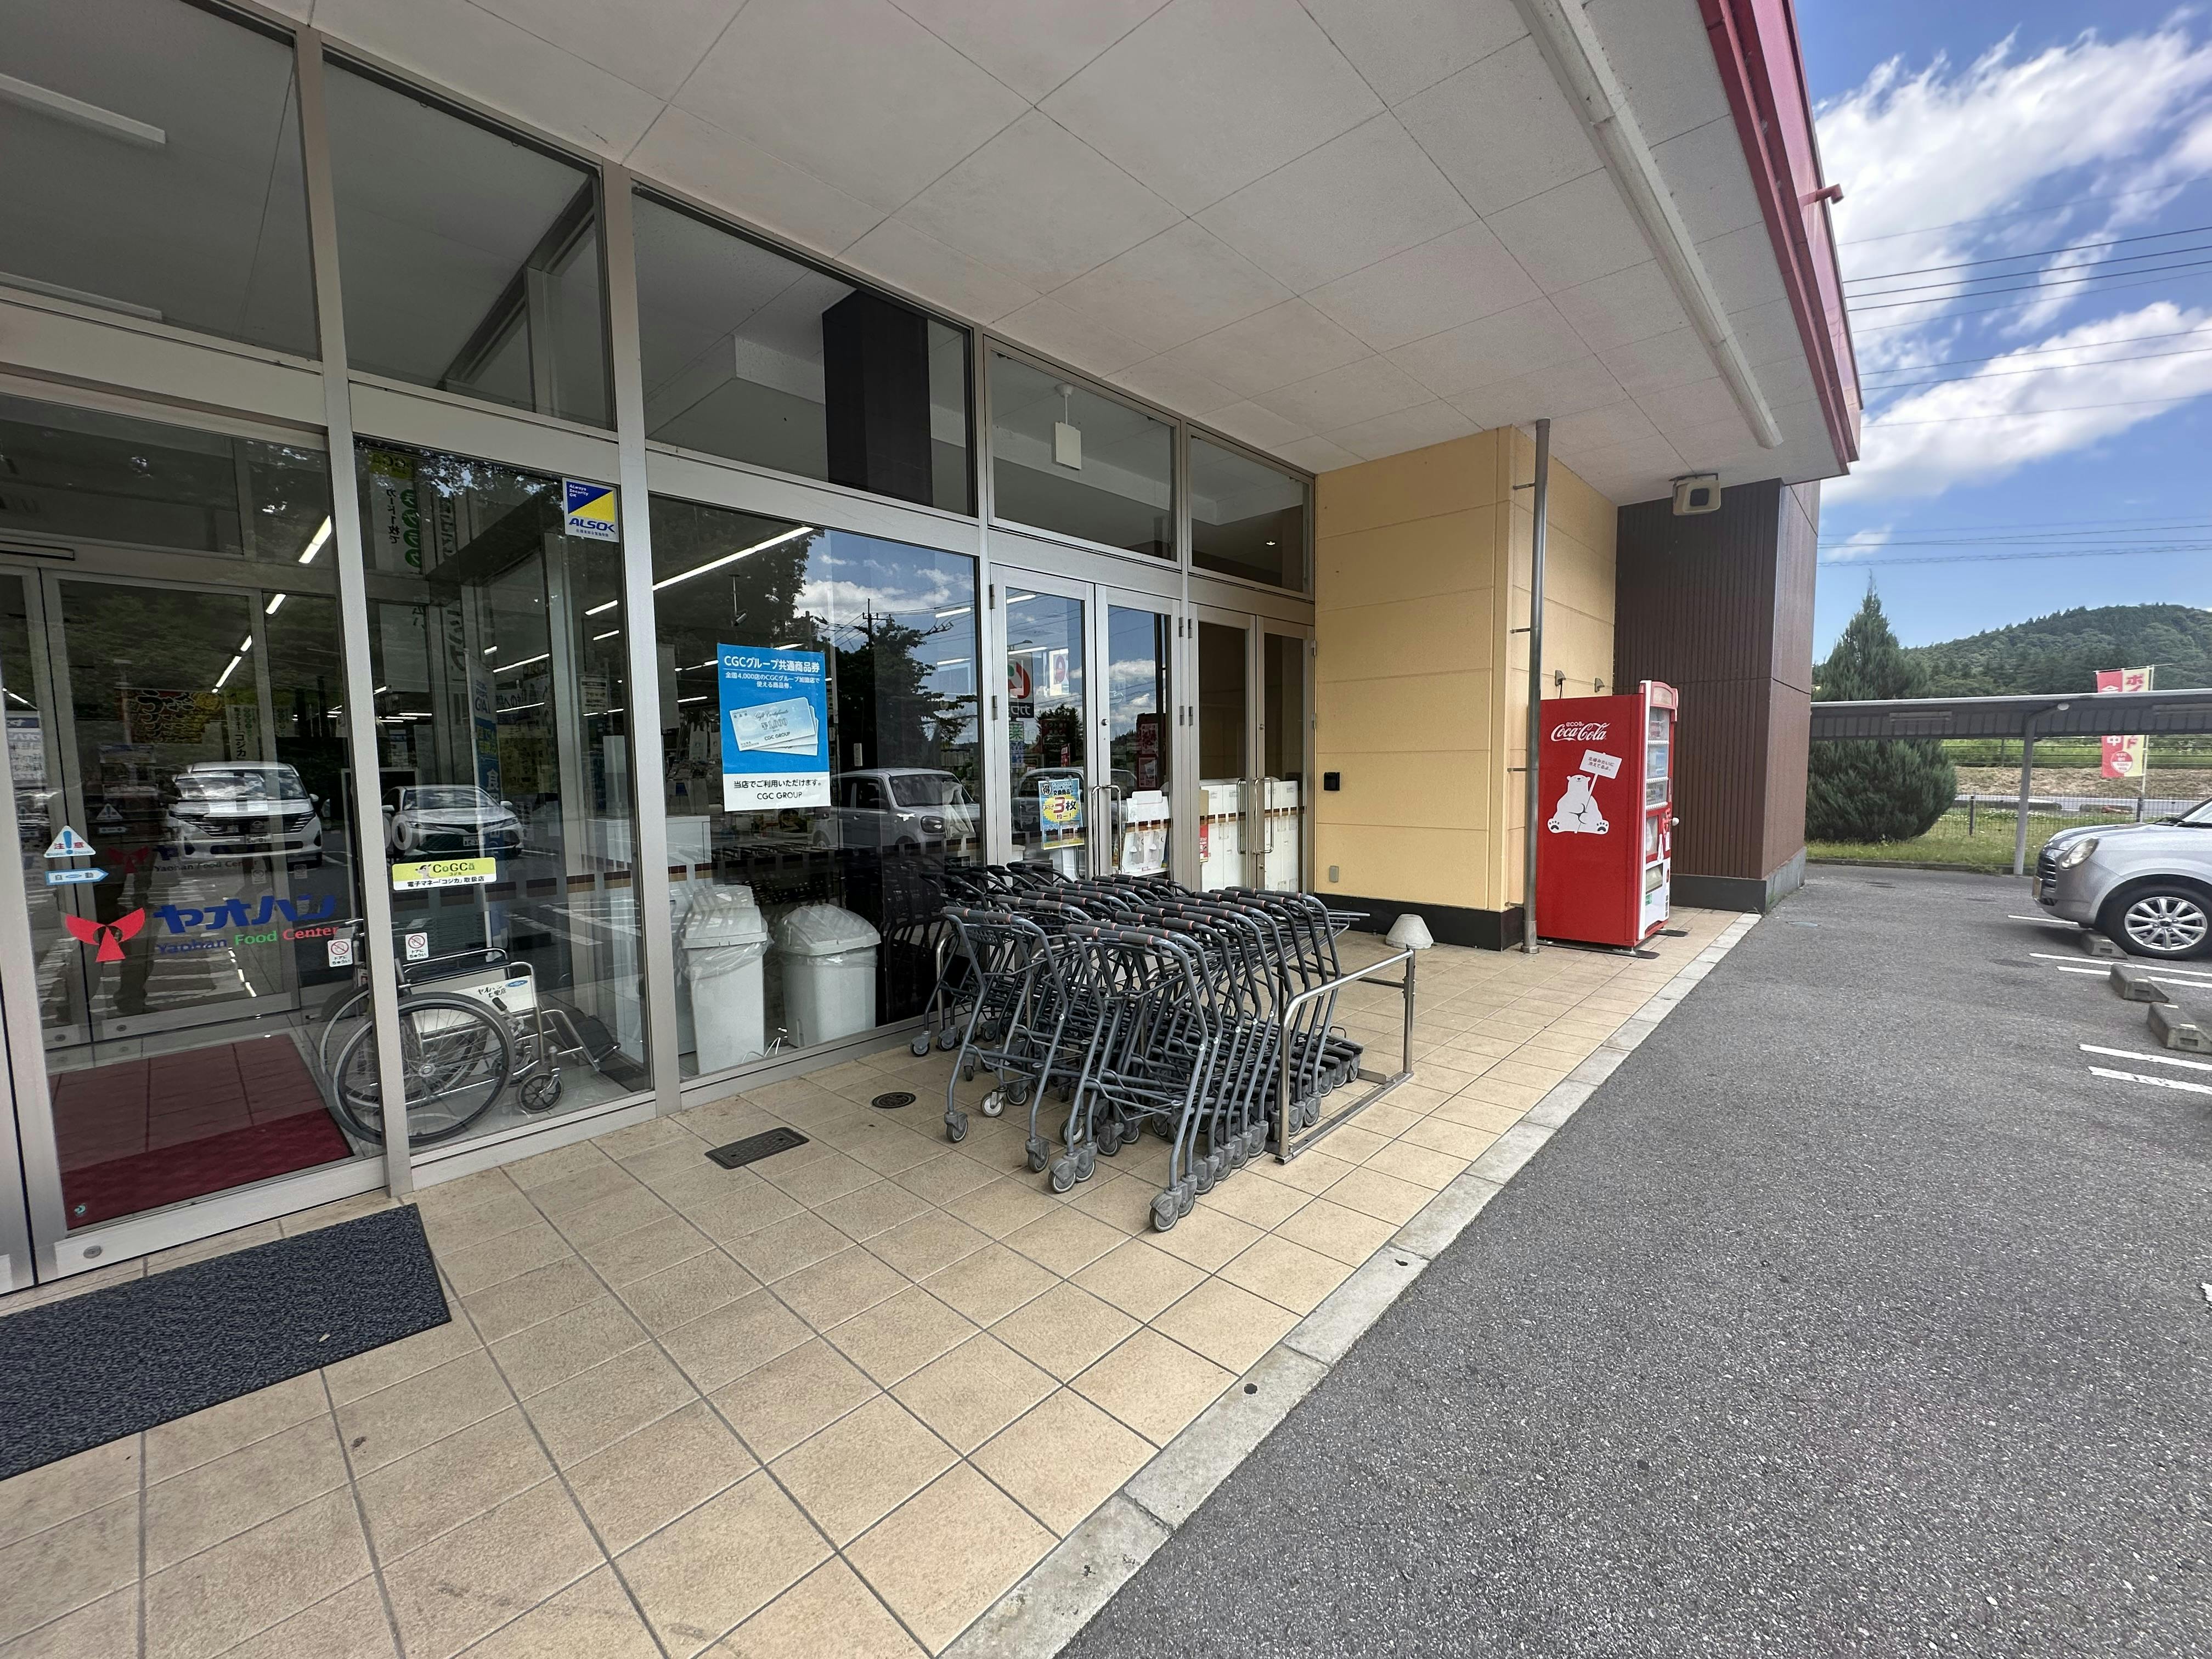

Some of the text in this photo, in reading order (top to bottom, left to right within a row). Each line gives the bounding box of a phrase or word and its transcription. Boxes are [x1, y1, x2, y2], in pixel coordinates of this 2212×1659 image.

[569, 517, 615, 533] ALSOK
[724, 655, 820, 673] CGCグループ共通商品券
[1550, 722, 1611, 742] Coca-Cola
[733, 779, 821, 789] 当店でご利用いただけます。
[153, 895, 337, 934] ヤオハン
[157, 926, 340, 955] Yaohan Food Center
